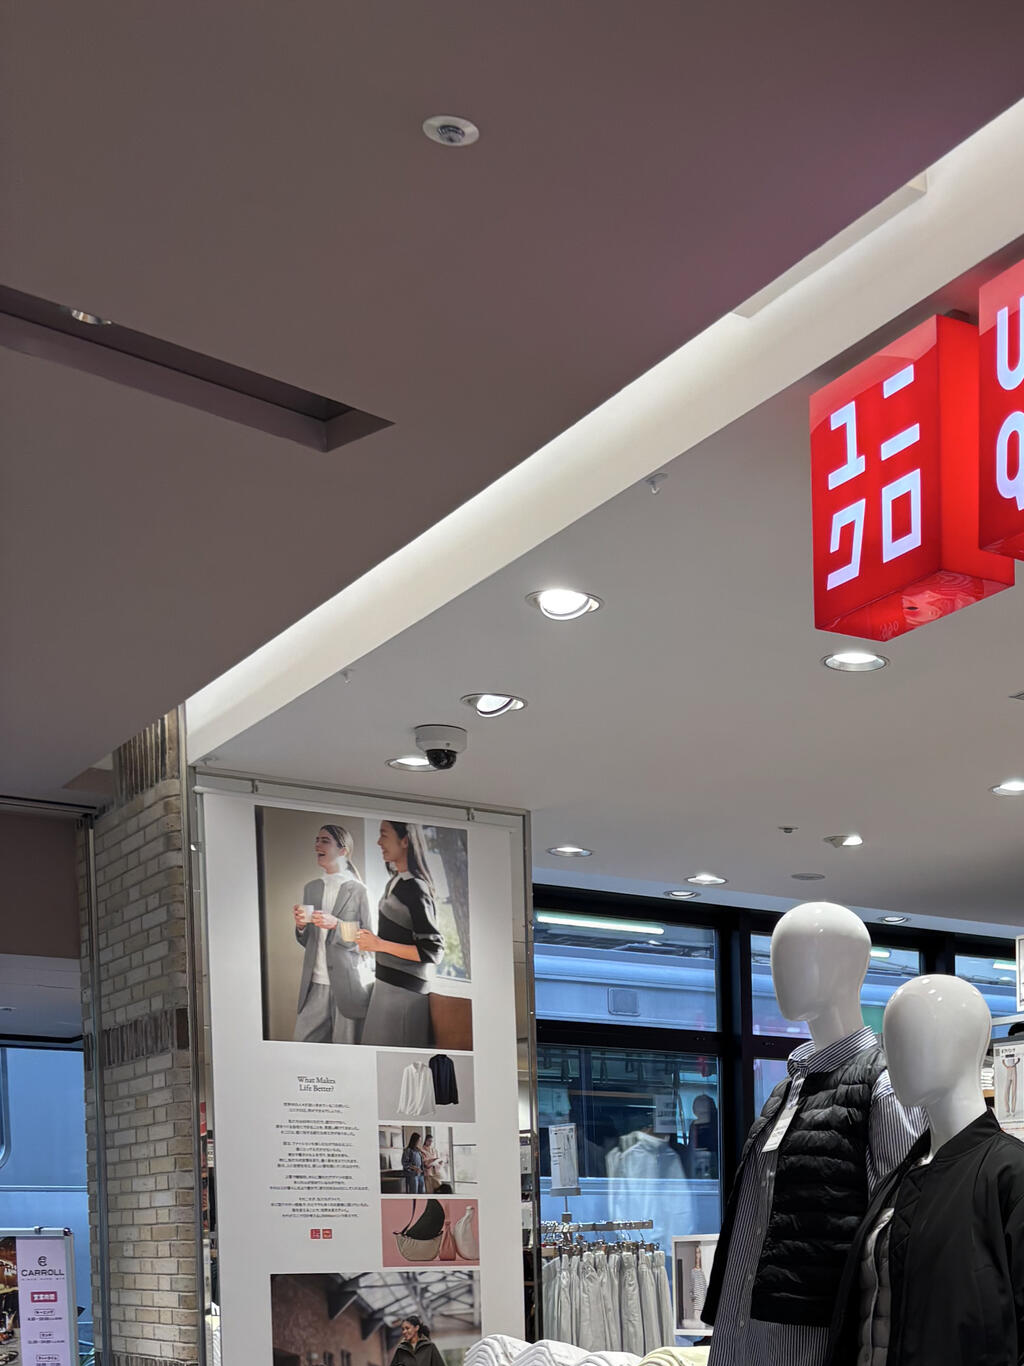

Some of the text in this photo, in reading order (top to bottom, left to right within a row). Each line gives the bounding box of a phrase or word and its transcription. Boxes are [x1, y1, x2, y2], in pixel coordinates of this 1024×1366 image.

[828, 363, 920, 491] ユニ
[826, 468, 922, 591] クロ
[21, 1269, 65, 1277] CARROLL
